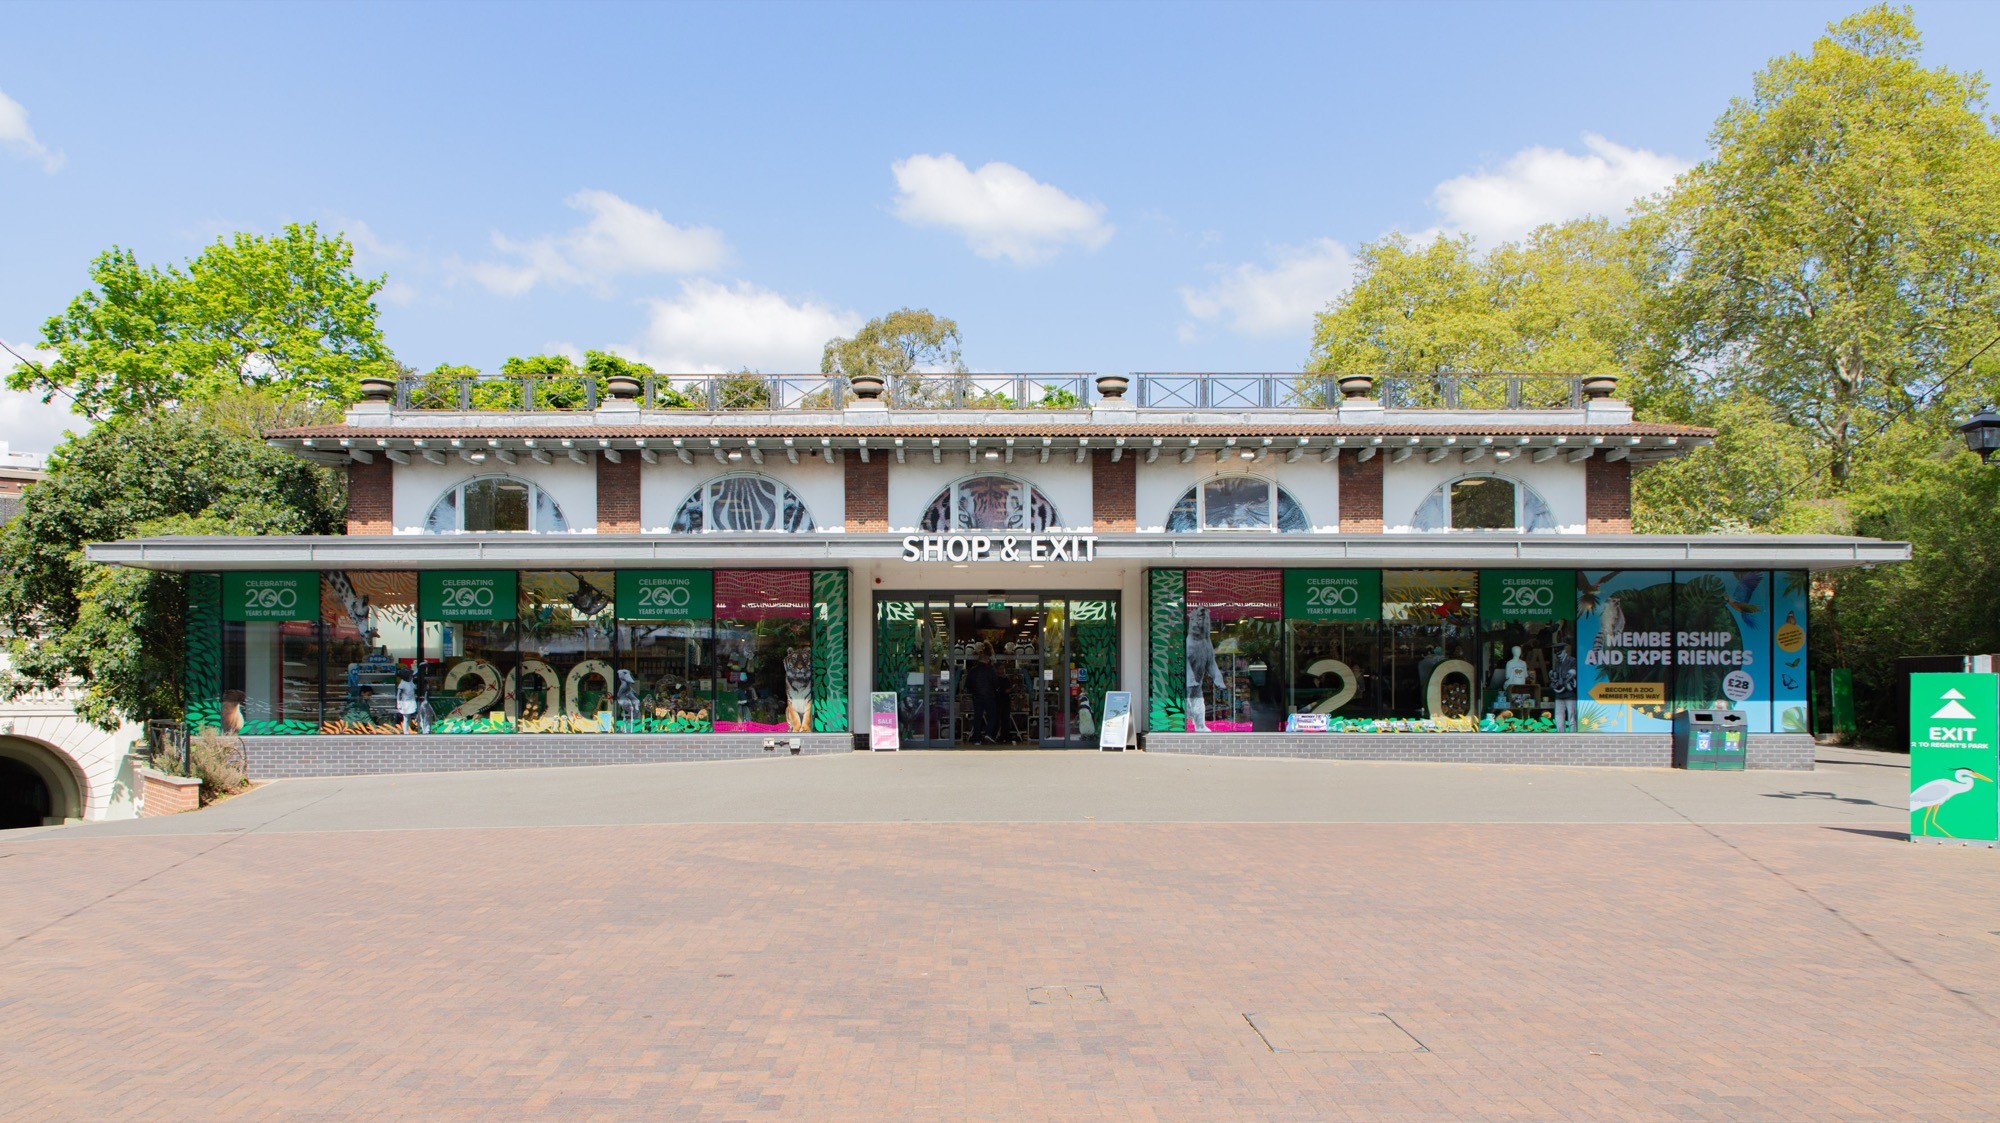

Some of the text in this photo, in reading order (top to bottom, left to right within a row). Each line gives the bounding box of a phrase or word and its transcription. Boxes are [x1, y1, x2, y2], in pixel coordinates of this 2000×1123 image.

[902, 535, 1099, 562] SHOP & EXIT
[245, 588, 296, 608] 200
[442, 587, 493, 607] 200
[638, 587, 690, 607] 200
[1306, 586, 1358, 606] 200
[1503, 586, 1554, 606] 200
[1585, 649, 1623, 665] AND
[1728, 678, 1749, 690] £28
[1929, 727, 1977, 741] EXIT
